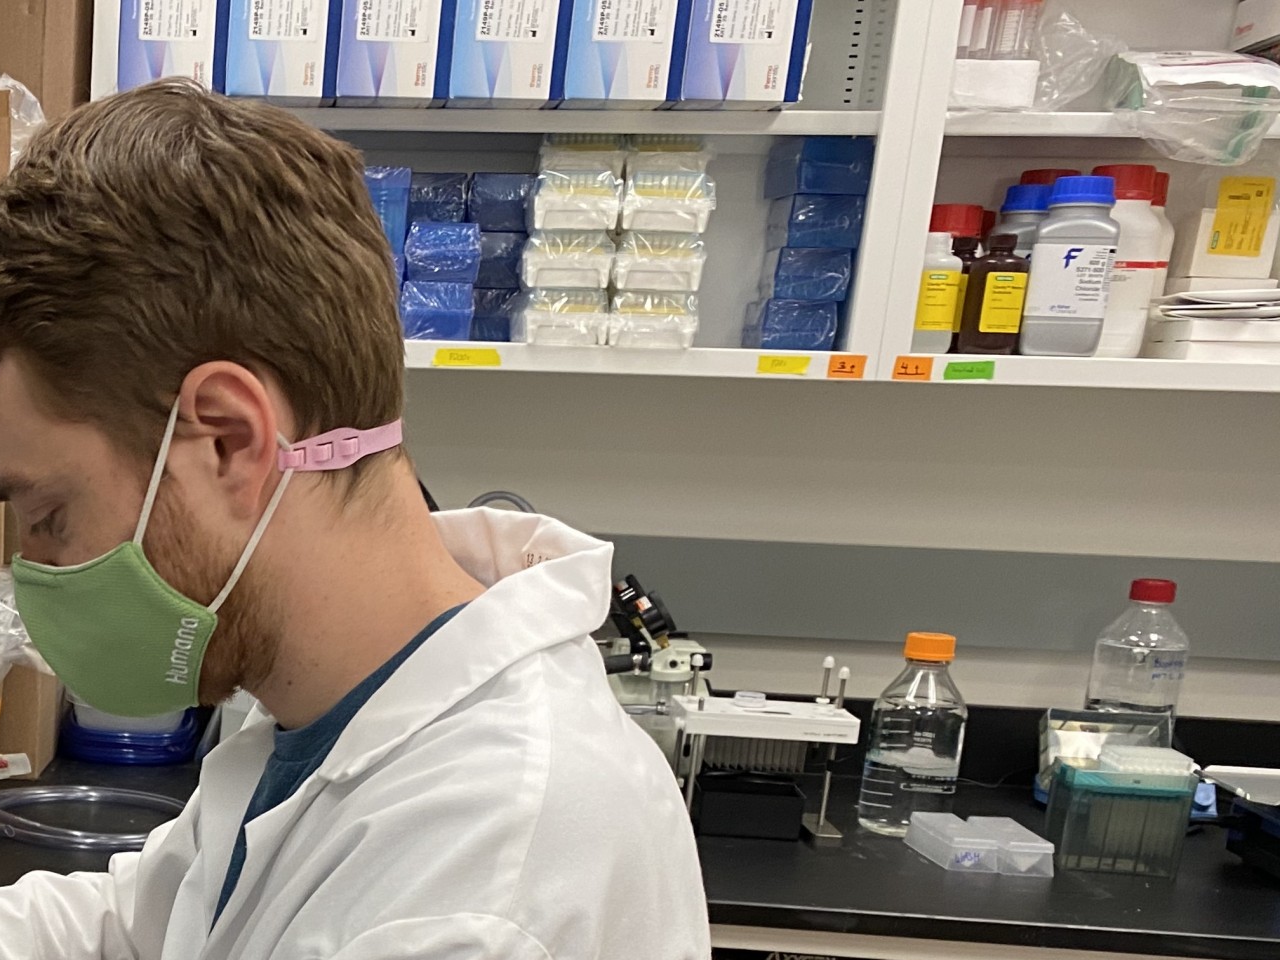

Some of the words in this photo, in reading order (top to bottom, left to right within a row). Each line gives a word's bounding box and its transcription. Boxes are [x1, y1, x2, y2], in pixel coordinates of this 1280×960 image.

[837, 361, 846, 370] 3
[900, 362, 909, 374] 4
[166, 616, 199, 686] Humana
